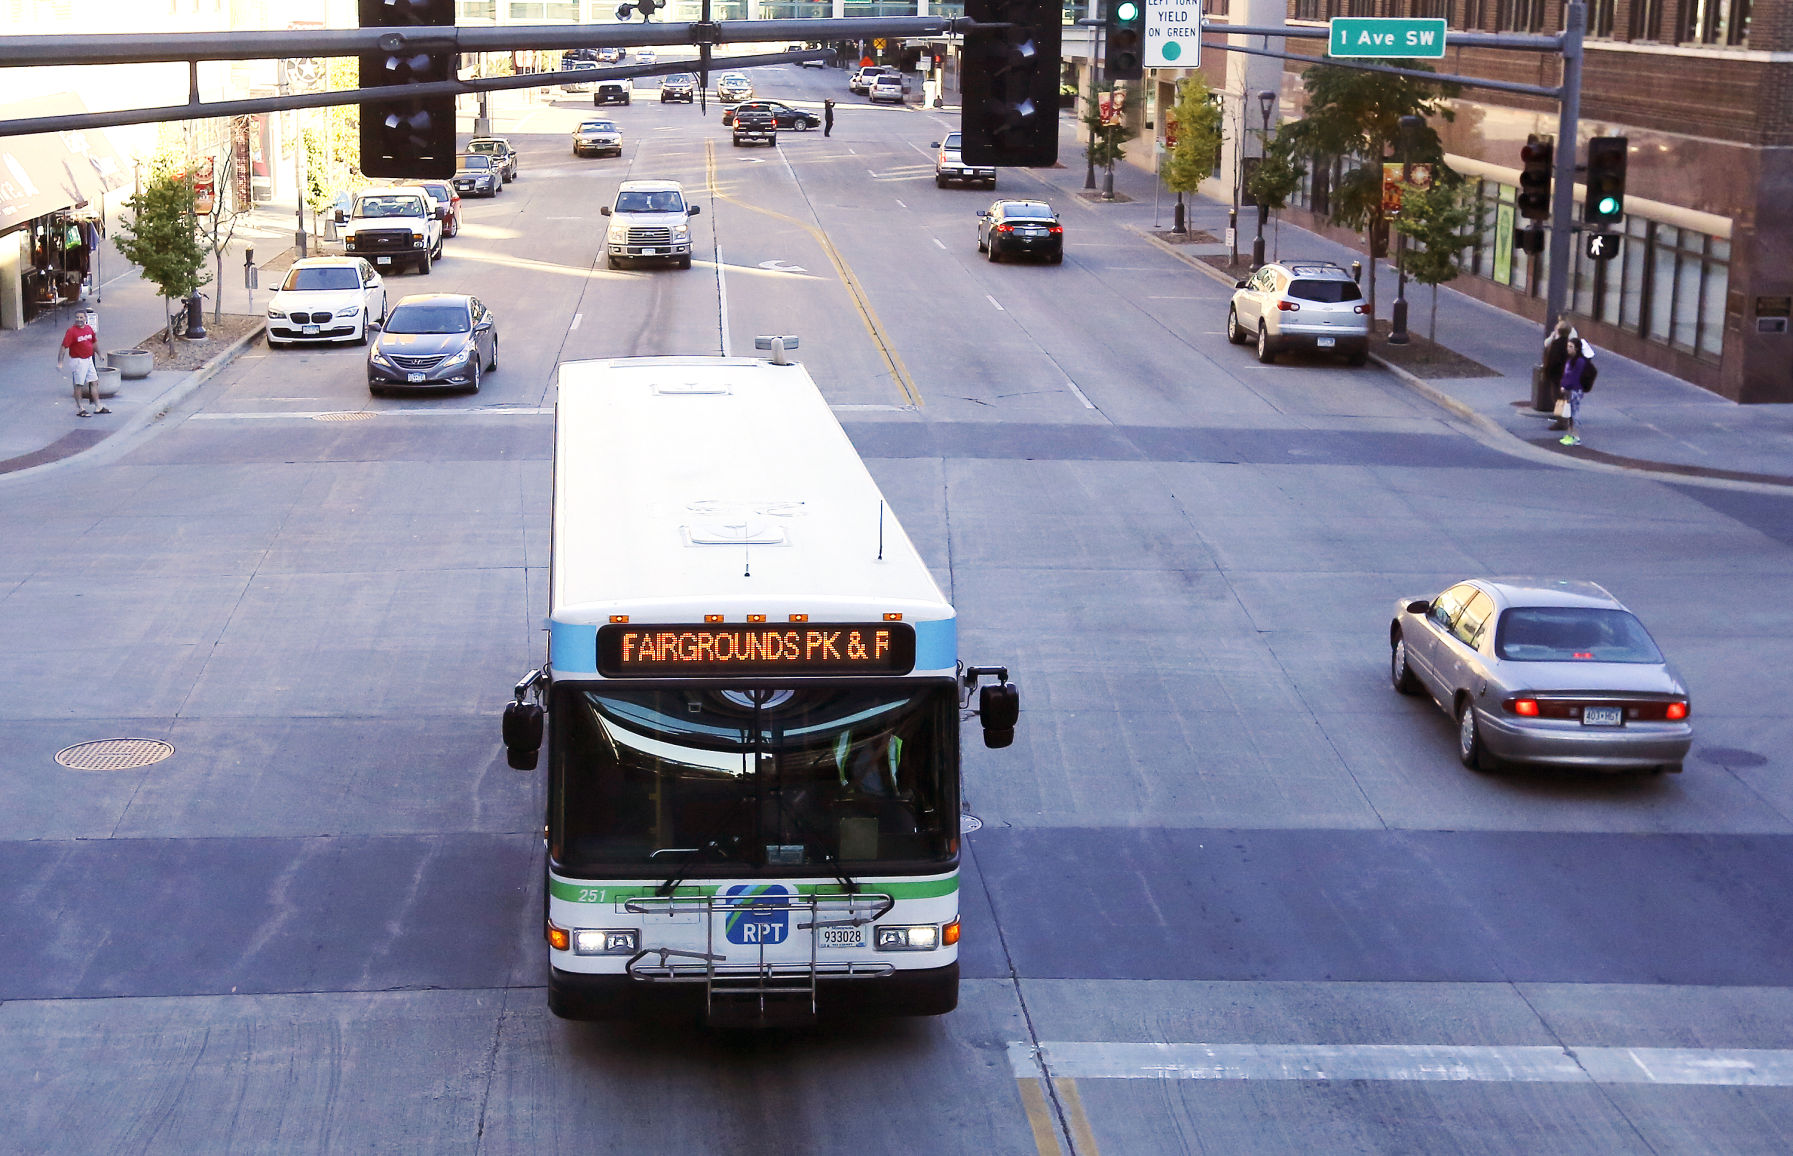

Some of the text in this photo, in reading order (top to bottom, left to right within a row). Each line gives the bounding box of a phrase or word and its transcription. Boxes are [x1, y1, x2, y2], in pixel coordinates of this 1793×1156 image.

[1159, 11, 1187, 21] YIELD
[1149, 28, 1196, 37] ON GREEN
[1341, 30, 1434, 46] 1 Ave SW
[623, 631, 800, 662] FAIRGROUNDS
[806, 631, 841, 660] PK
[847, 631, 868, 660] &
[578, 889, 606, 902] 251
[743, 923, 784, 942] RPT
[824, 930, 862, 943] 933028
